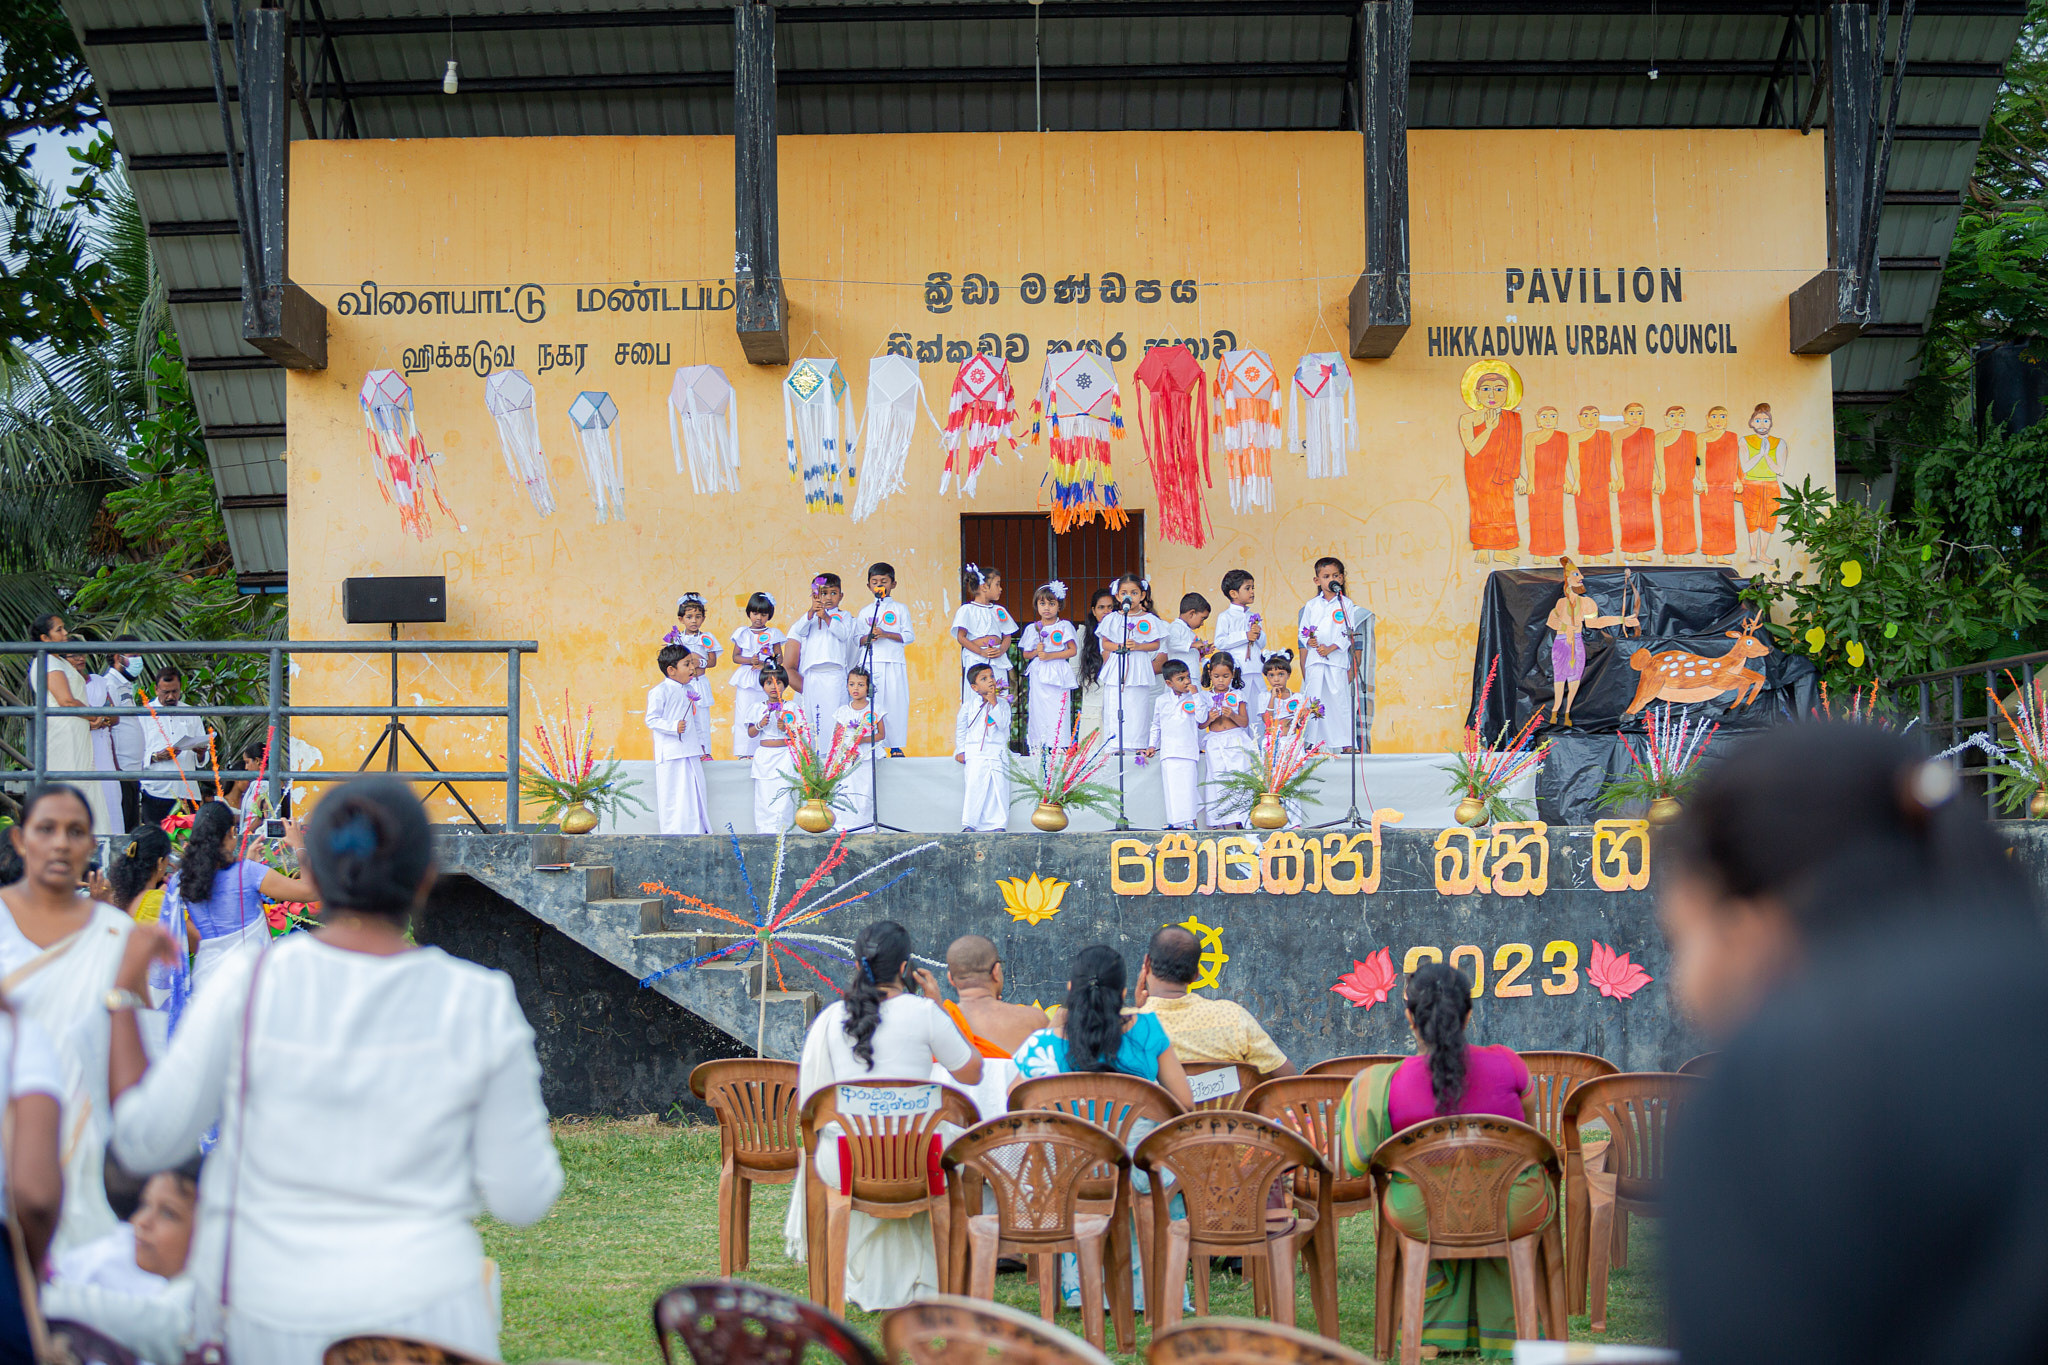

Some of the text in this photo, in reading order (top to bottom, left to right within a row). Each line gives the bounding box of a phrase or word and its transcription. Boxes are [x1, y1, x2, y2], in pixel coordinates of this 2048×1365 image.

[337, 279, 736, 324] விளையாட்டு மண்டபம்
[1505, 266, 1682, 304] PAVILION
[402, 339, 671, 378] ஹிக்கடுவ நகர சபை
[1427, 322, 1738, 357] HIKKADUWA URBAN COUNCIL
[1110, 808, 1405, 896] පොසොන්
[1433, 820, 1550, 897] බැති
